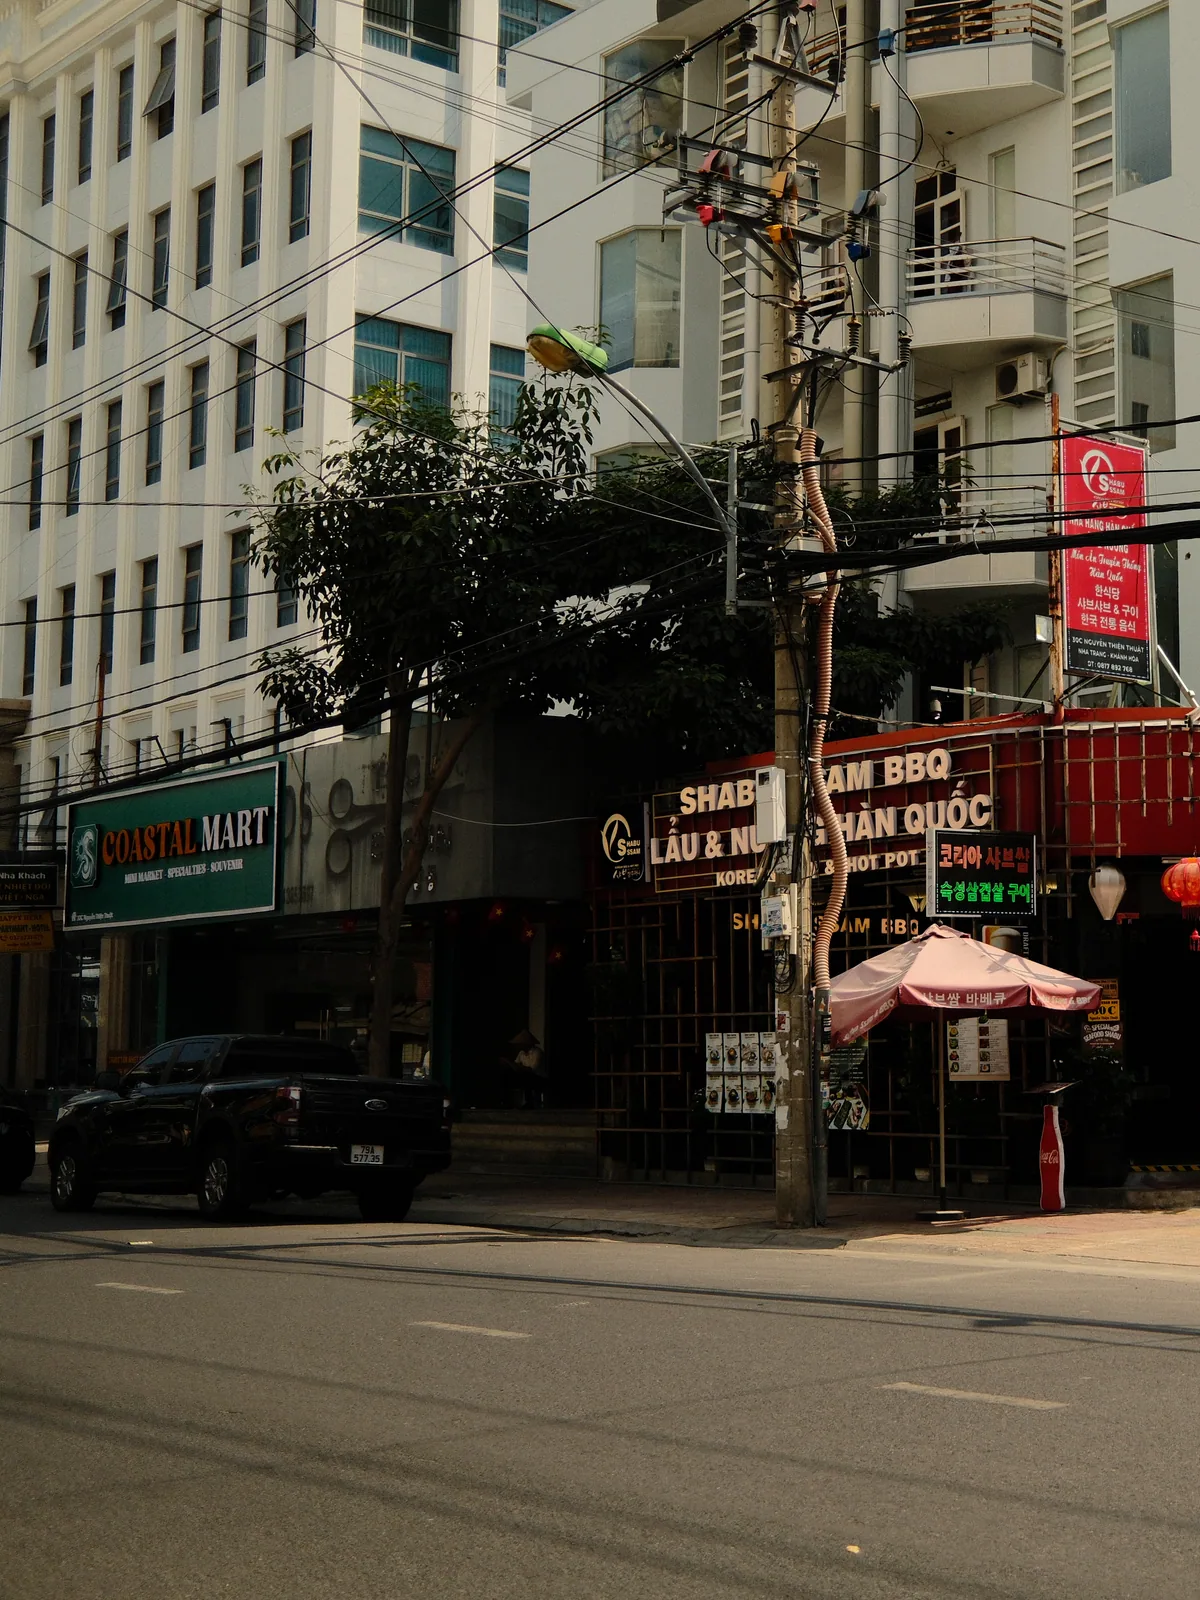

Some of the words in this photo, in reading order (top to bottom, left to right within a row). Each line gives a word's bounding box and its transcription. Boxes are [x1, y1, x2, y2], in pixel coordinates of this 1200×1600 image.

[1095, 583, 1120, 600] 한식당
[1078, 597, 1112, 616] 샤브샤브
[1113, 603, 1121, 615] &
[1122, 604, 1140, 619] 구이
[1081, 613, 1098, 628] 한국
[1100, 616, 1117, 631] 전통
[1119, 619, 1136, 634] 음식
[679, 778, 758, 815] SHAB
[884, 747, 952, 786] BBQ
[903, 781, 993, 835] QUỐC
[102, 817, 197, 866] COASTAL
[201, 805, 270, 852] MART
[650, 816, 703, 866] LẨU
[705, 830, 728, 859] &
[845, 853, 881, 873] HOT
[884, 848, 920, 870] POT
[939, 843, 983, 870] 코리아
[138, 868, 164, 882] MARKET
[210, 858, 243, 874] SOUVENIR
[940, 881, 1004, 903] 숙성삼겹살
[1022, 931, 1030, 957] DRAFT
[966, 991, 1007, 1006] 바베큐
[353, 1154, 381, 1163] 577.35
[360, 1145, 375, 1155] 79A
